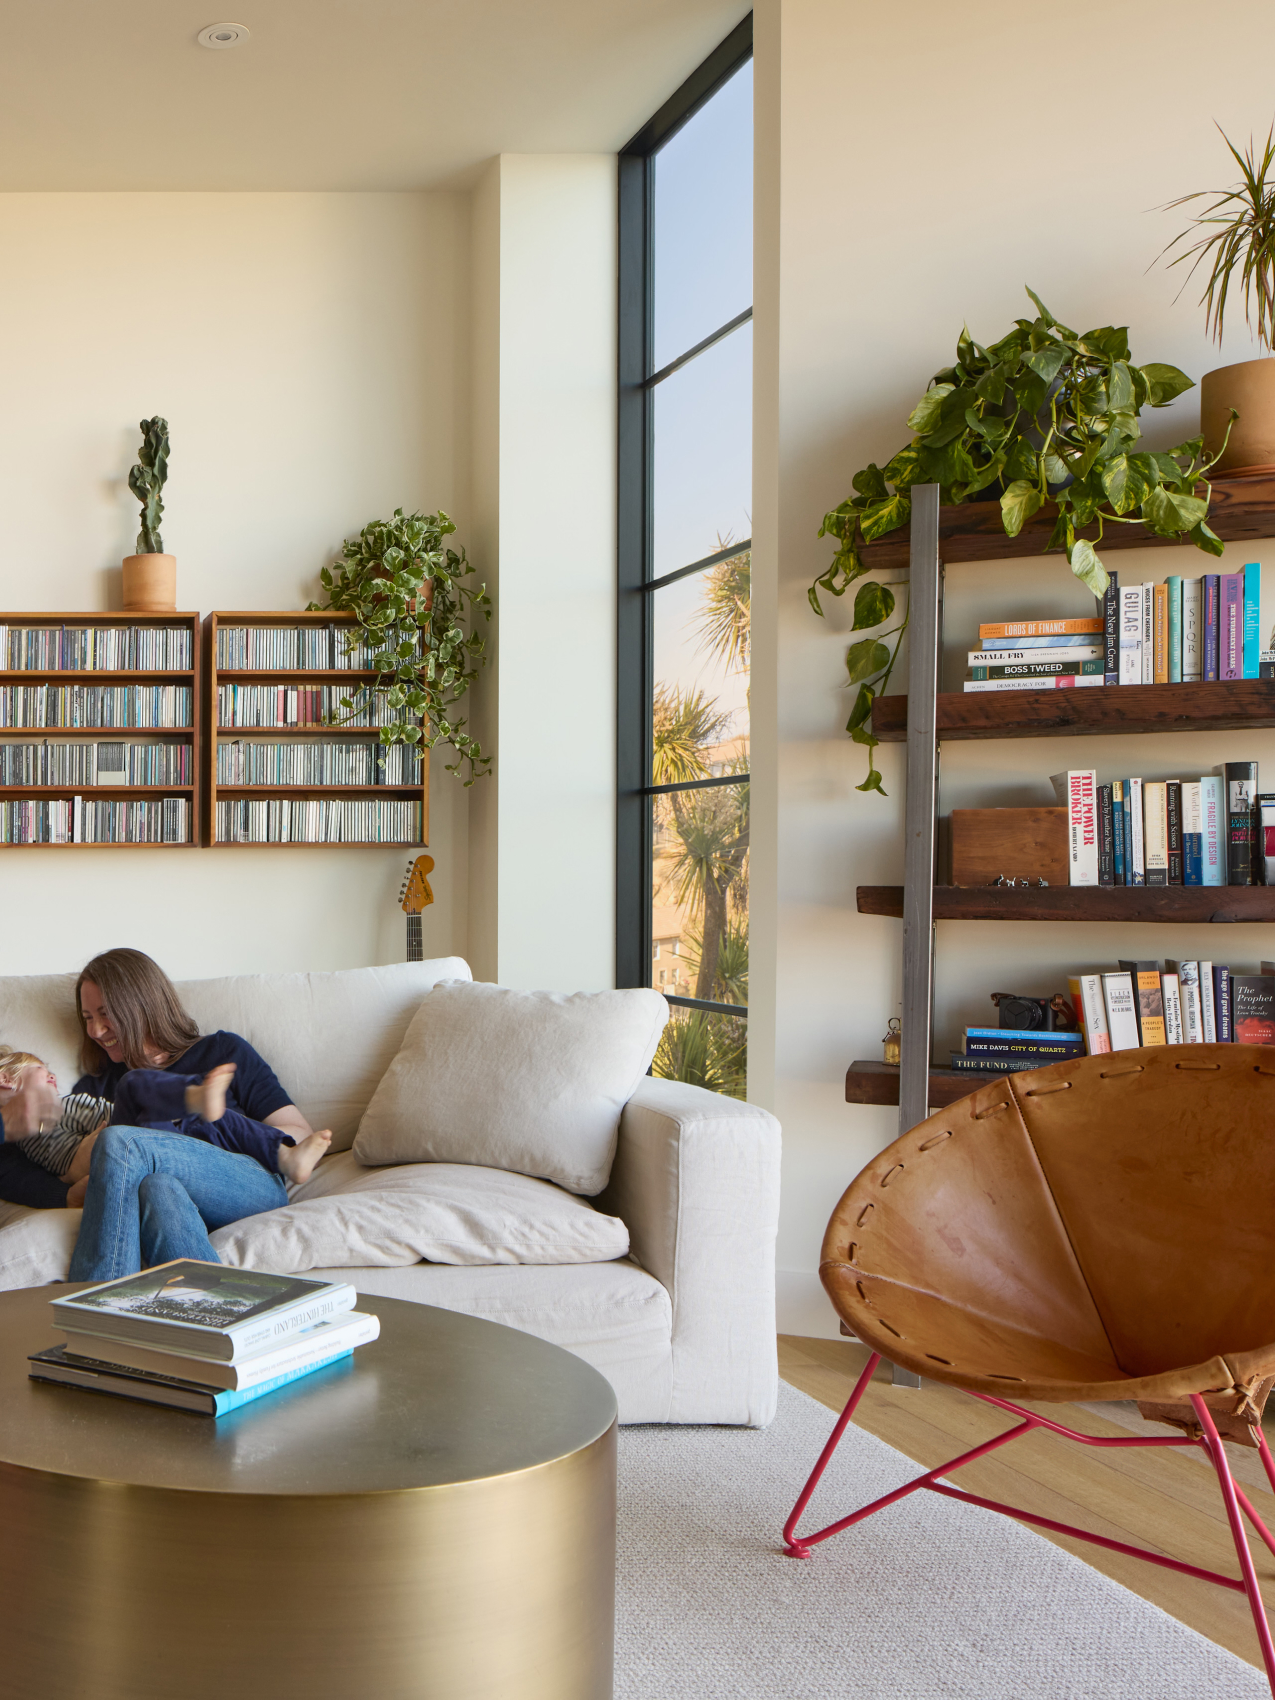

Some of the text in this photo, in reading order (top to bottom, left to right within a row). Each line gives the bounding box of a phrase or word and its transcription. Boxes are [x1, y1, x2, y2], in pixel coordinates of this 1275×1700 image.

[1124, 592, 1139, 632] GULAG
[1005, 624, 1026, 636] LORDS
[1028, 623, 1037, 635] OF
[1039, 621, 1067, 634] FINANCE
[1106, 601, 1116, 669] The New Jim Crow
[973, 652, 1005, 661] SMALL
[1005, 663, 1063, 674] BOSS TWEED
[1070, 776, 1082, 826] BROKER
[1082, 773, 1094, 846] THE POWER
[1102, 787, 1110, 807] Slavery
[1168, 785, 1177, 811] Running
[1191, 790, 1200, 812] World
[1103, 814, 1111, 836] Another
[1192, 814, 1201, 858] Transformed
[1207, 802, 1217, 866] FRAGILE BY DESIGN
[1204, 985, 1212, 1018] DEMOCRACY
[1237, 995, 1273, 1004] Prophet
[1238, 986, 1255, 994] The
[1088, 979, 1096, 992] The
[1093, 1017, 1101, 1030] Sex
[1221, 1000, 1229, 1015] great
[980, 1061, 1008, 1069] FUND
[274, 1301, 334, 1335] THE HINTERLAND
[243, 1389, 256, 1401] THE
[257, 1379, 276, 1395] MAGIC
[277, 1375, 285, 1385] OF
